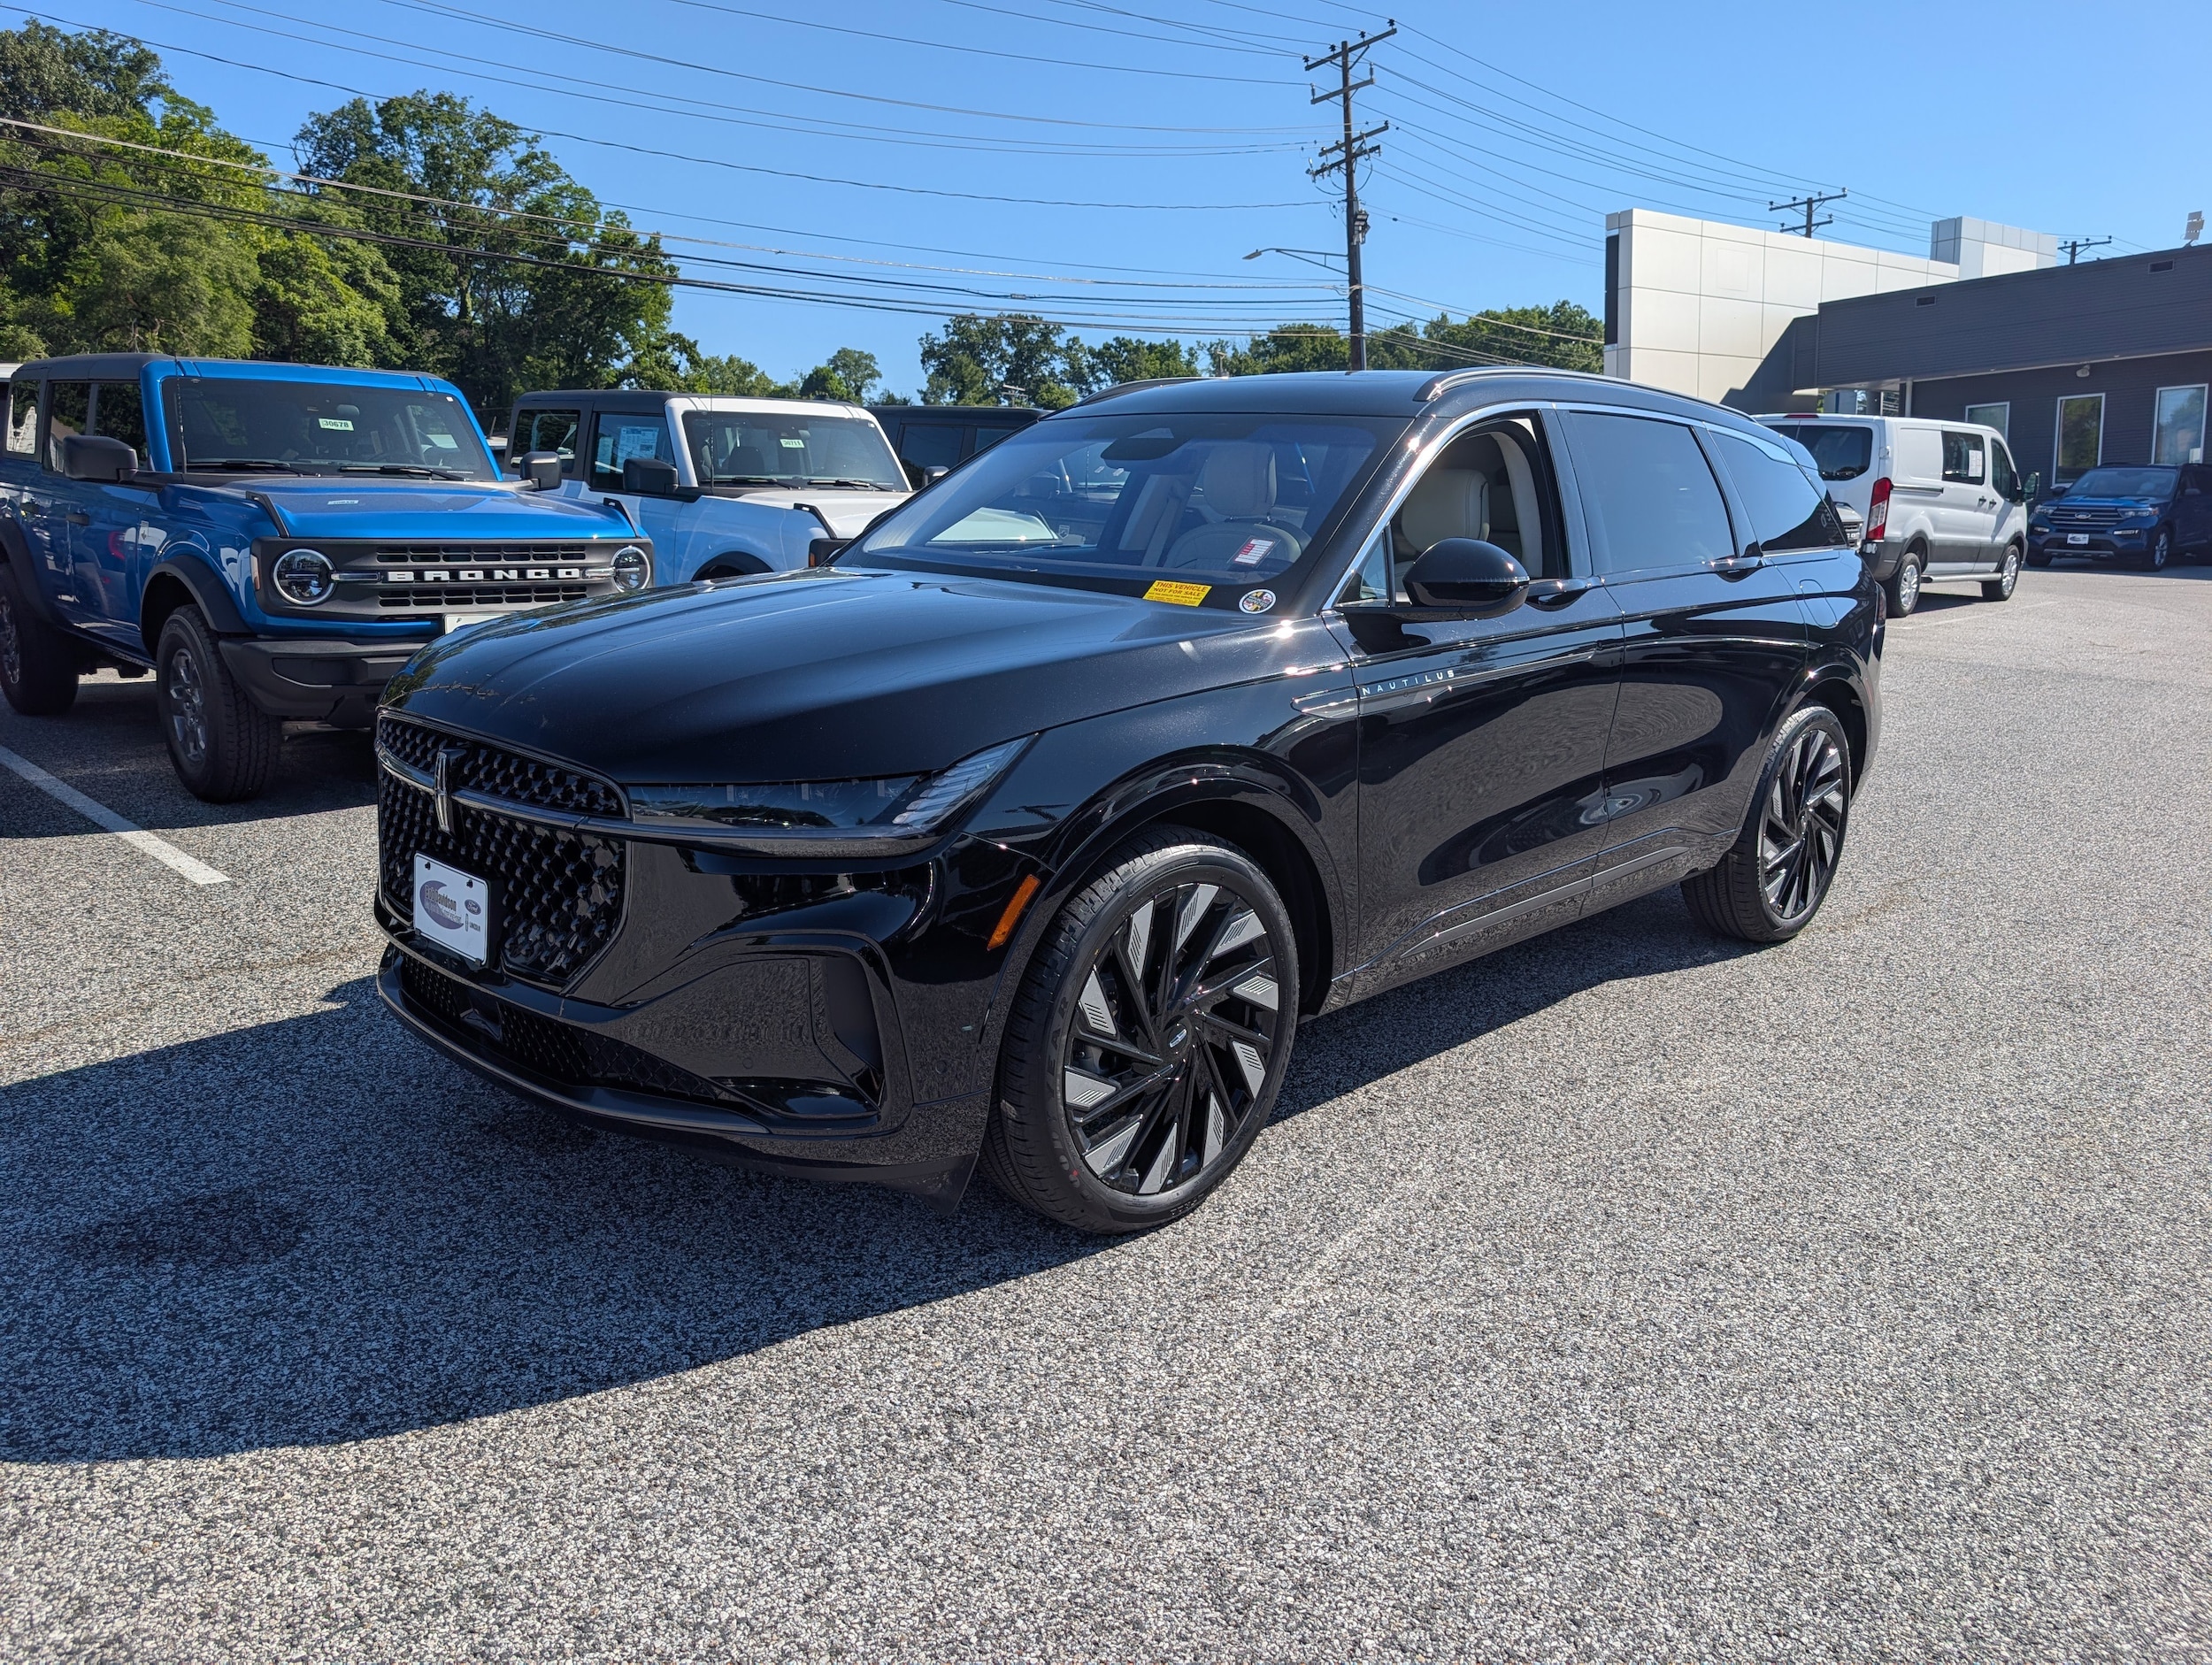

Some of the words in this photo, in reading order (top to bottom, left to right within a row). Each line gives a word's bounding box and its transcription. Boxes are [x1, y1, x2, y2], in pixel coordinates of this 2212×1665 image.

[387, 568, 580, 582] BRONCO
[1174, 584, 1209, 593] VEHICLE
[1362, 670, 1455, 696] NAUTILUS
